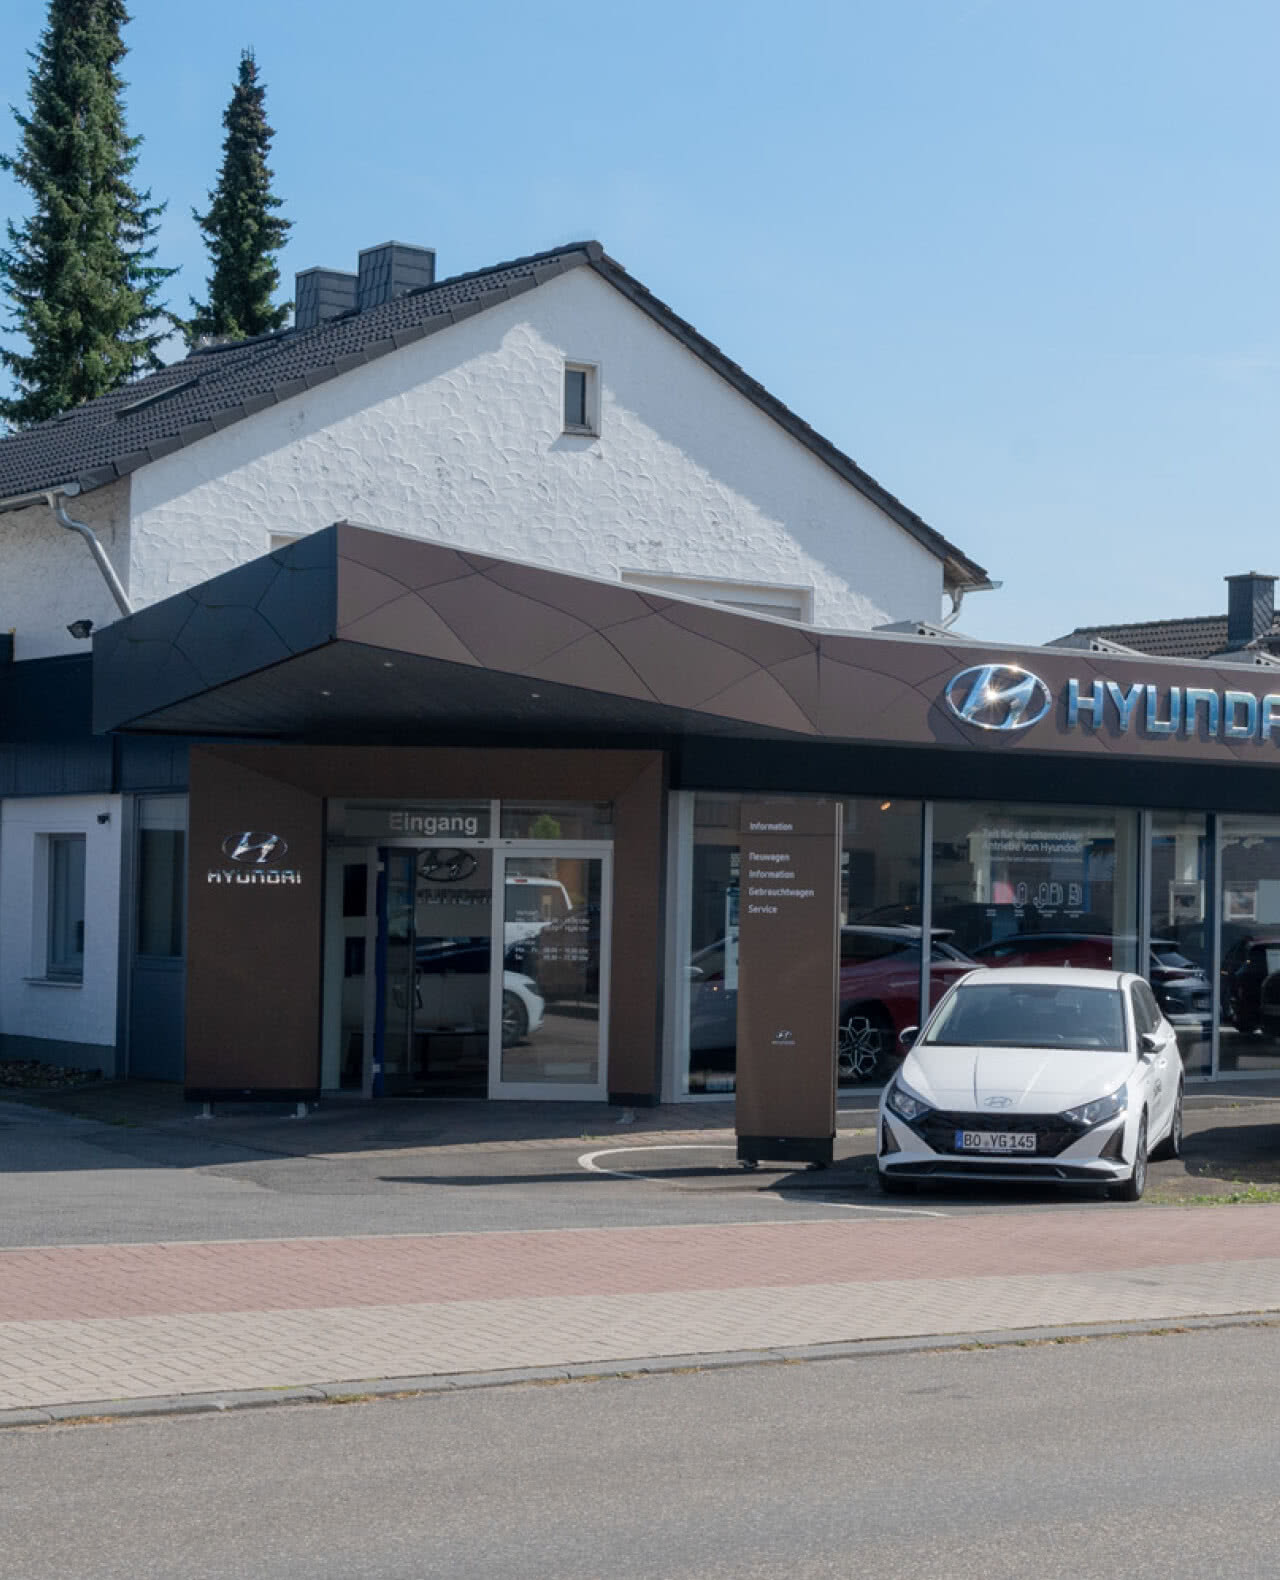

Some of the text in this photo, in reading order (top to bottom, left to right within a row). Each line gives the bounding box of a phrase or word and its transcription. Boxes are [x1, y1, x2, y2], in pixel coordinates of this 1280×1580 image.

[389, 812, 479, 835] Eingang
[749, 822, 793, 831] Information
[748, 852, 790, 863] Neuwagen
[207, 869, 301, 884] HYUNDAI
[748, 870, 795, 879] Information
[748, 887, 815, 898] Gebrauchtwagen
[748, 904, 778, 914] Service
